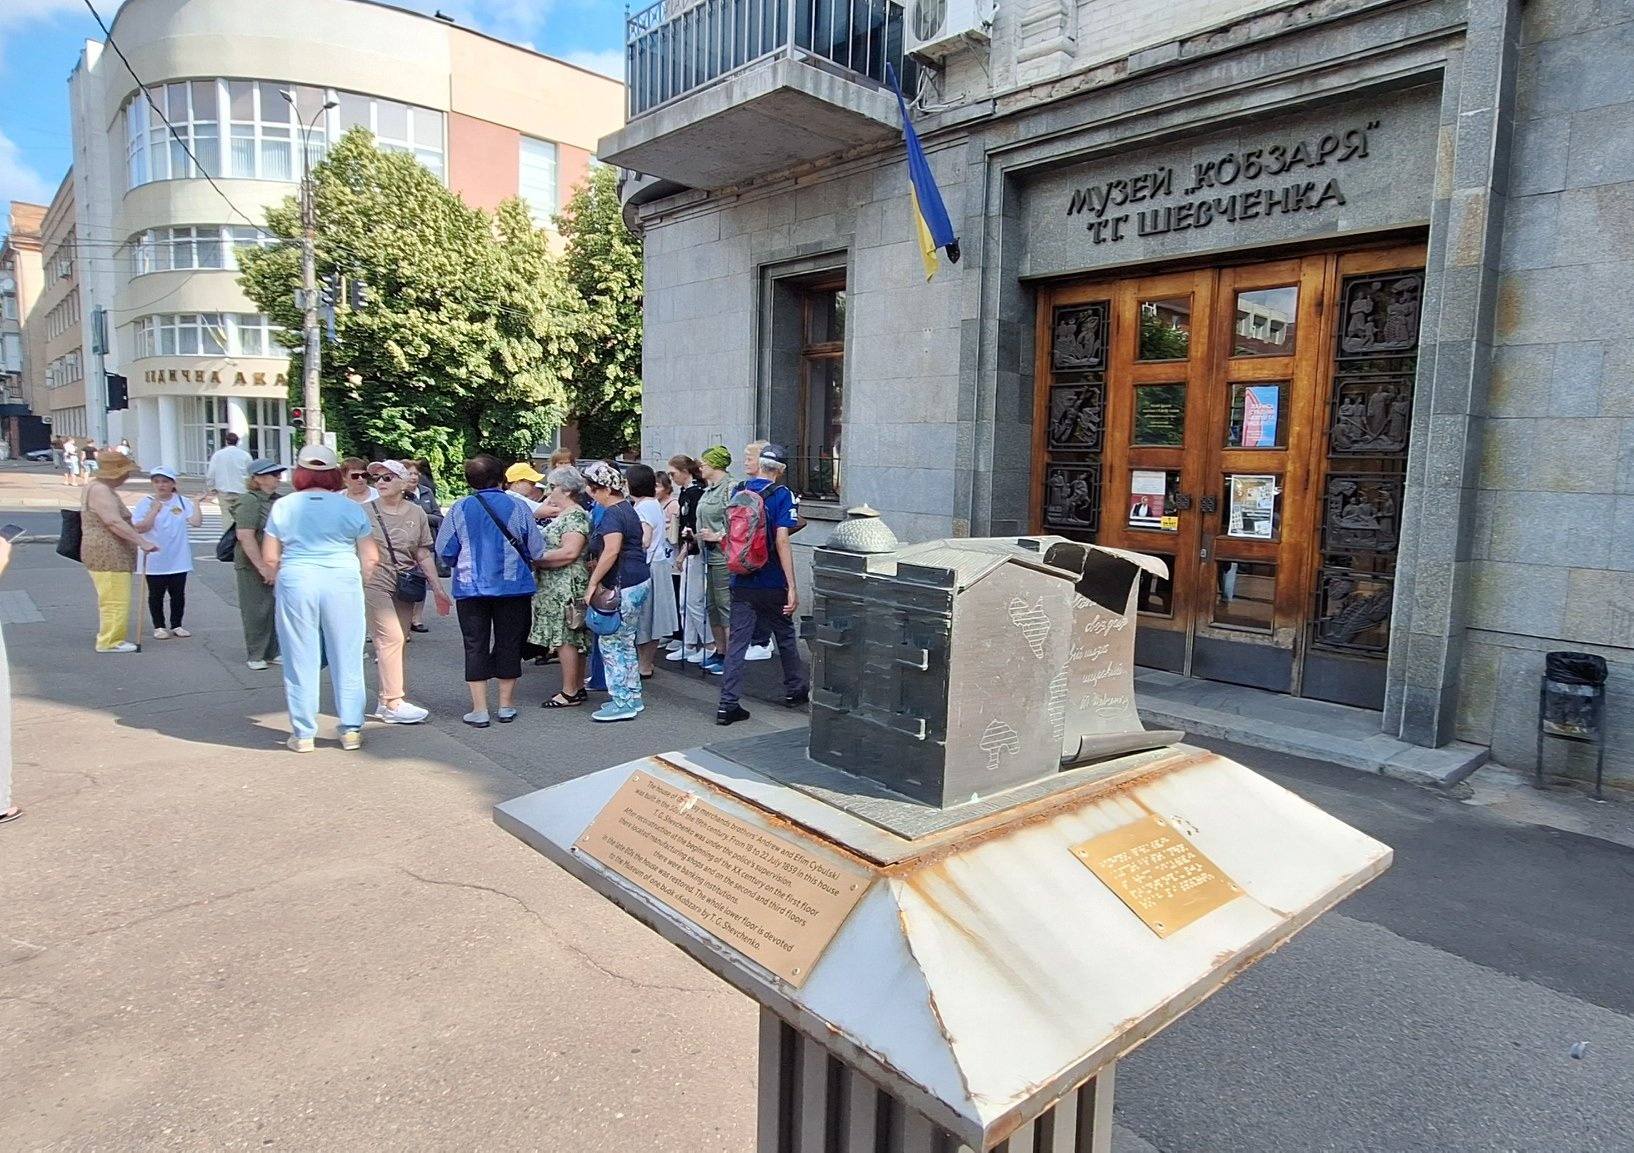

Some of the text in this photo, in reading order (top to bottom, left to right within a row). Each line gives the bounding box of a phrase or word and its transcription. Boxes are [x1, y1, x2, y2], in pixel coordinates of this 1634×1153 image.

[1067, 166, 1173, 217] МУЗЕЙ
[1137, 177, 1346, 237] ШЕВЧЕНКА
[233, 371, 289, 387] АКА
[678, 866, 705, 885] banking
[684, 840, 716, 861] beginning
[739, 869, 766, 888] century
[756, 835, 782, 851] Andrew
[807, 860, 840, 882] Cybulski
[733, 881, 757, 898] second
[817, 880, 840, 896] house
[668, 873, 697, 893] restored.
[763, 929, 794, 952] devoted
